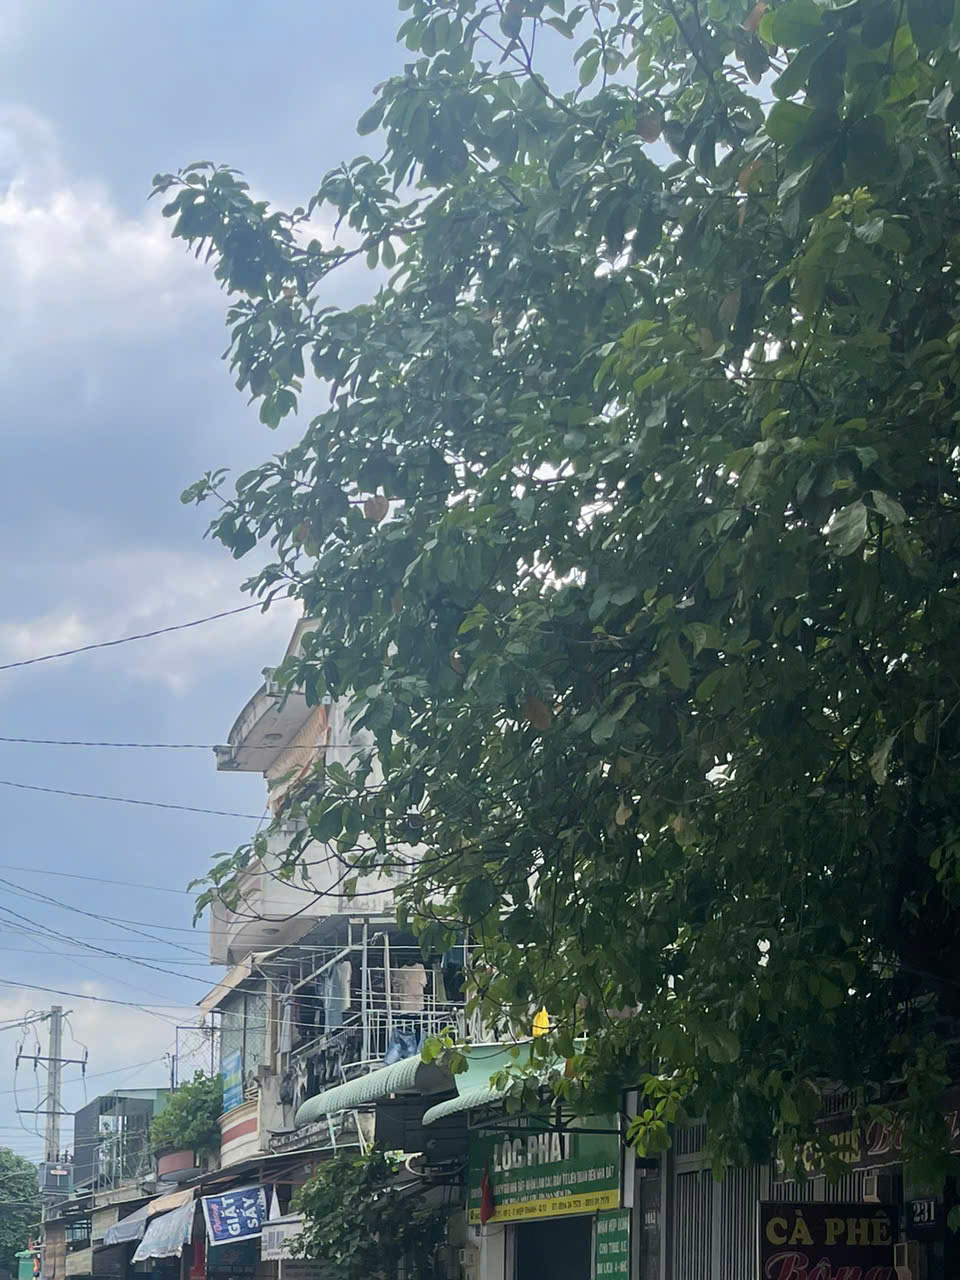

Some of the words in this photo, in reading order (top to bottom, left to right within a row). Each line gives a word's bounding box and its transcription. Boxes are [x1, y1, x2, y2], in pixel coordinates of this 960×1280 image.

[494, 1134, 523, 1177] LỘC
[220, 1197, 241, 1236] GIẶT
[240, 1197, 259, 1228] SẤY
[765, 1209, 814, 1245] CÀ
[824, 1210, 892, 1246] PHÊ
[912, 1201, 935, 1223] 231
